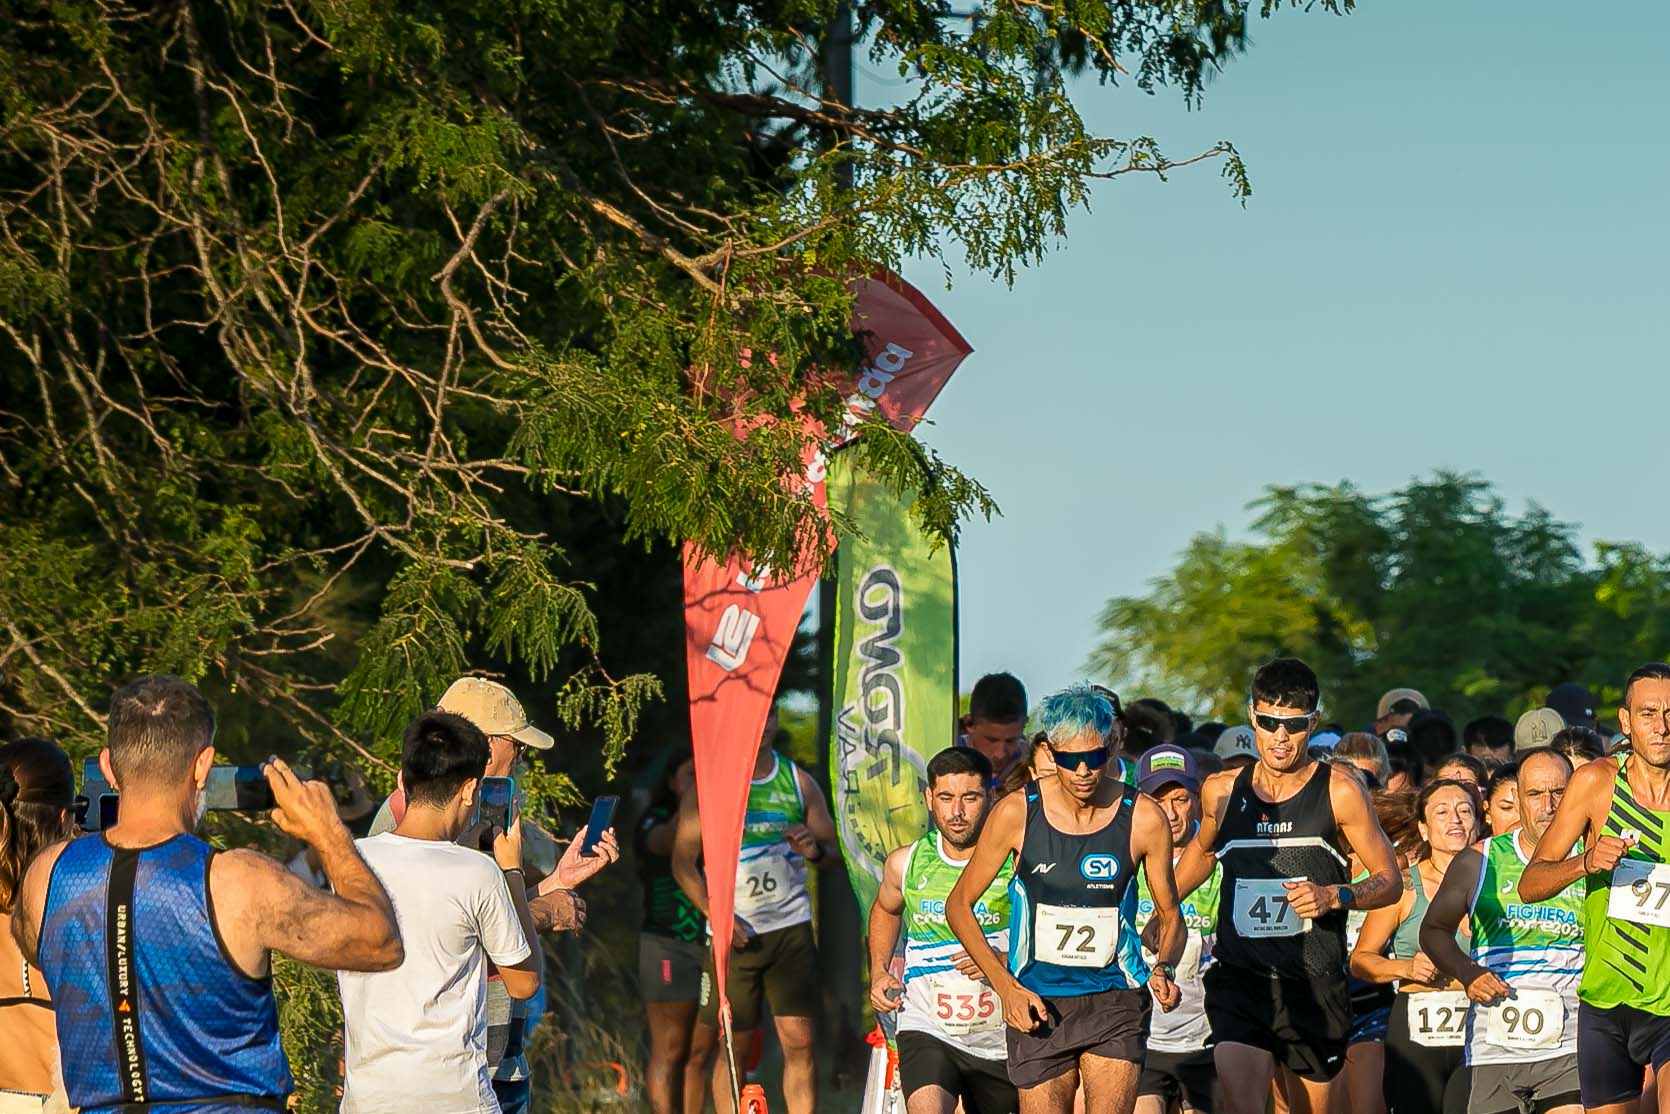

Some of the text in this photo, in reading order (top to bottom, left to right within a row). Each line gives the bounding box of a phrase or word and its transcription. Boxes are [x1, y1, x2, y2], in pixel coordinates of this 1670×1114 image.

[1257, 821, 1293, 833] ATENAS
[746, 872, 777, 898] 26
[1248, 896, 1290, 924] 47
[1507, 904, 1577, 924] FIGHIERA
[117, 905, 129, 996] URBAN/LUXURY
[1055, 924, 1096, 953] 72
[936, 991, 995, 1021] 535
[1418, 1006, 1468, 1033] 127
[1502, 1006, 1544, 1035] 90
